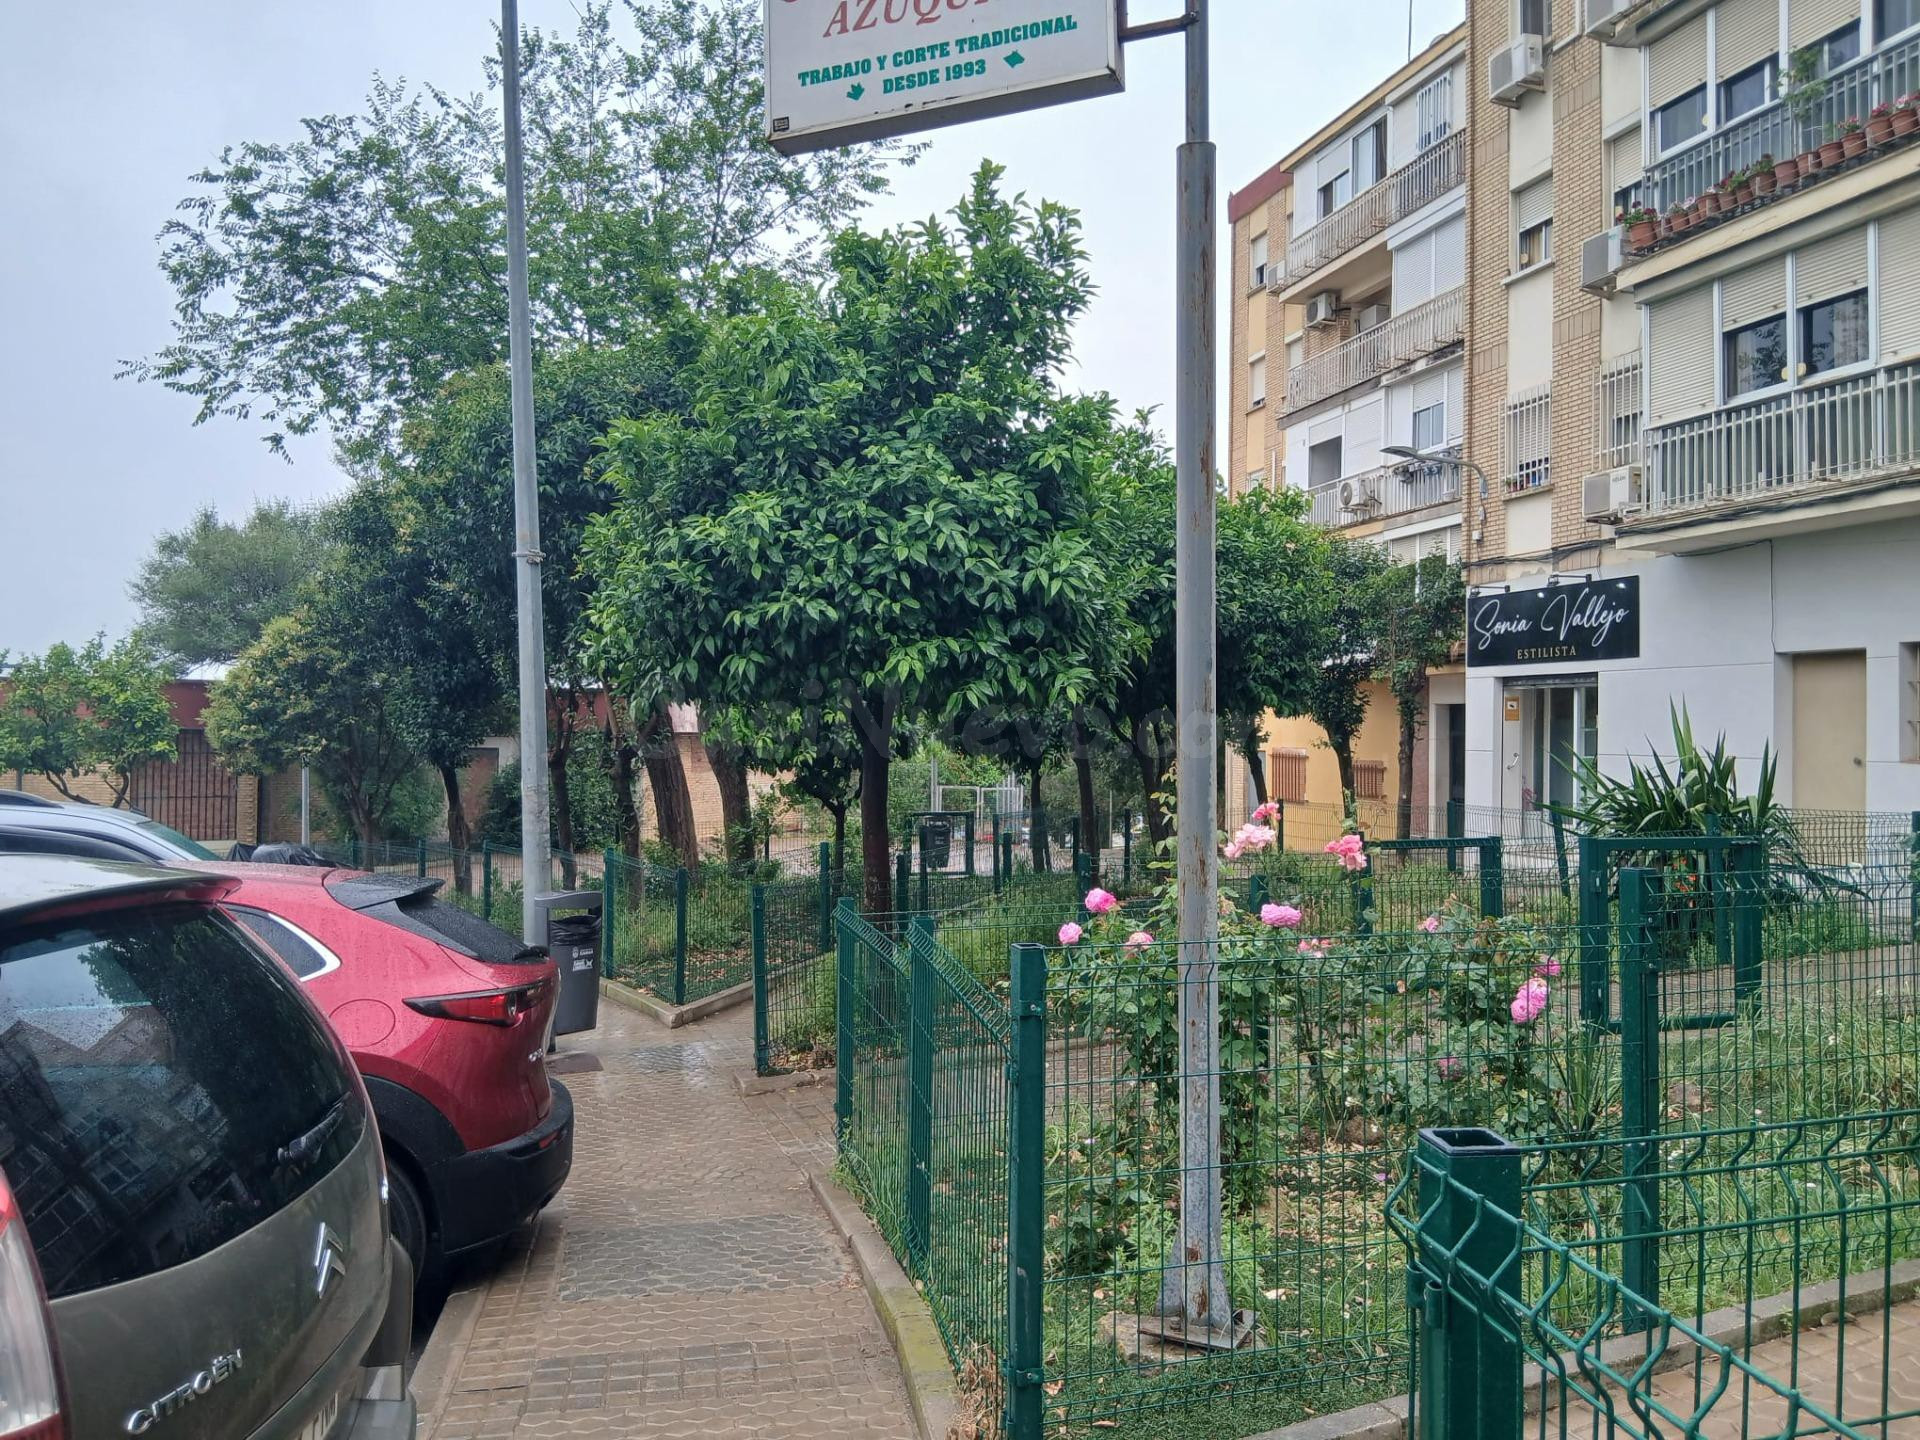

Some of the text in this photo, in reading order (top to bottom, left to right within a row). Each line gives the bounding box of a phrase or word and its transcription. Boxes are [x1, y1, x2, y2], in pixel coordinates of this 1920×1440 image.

[823, 0, 989, 37] AZUQ
[797, 14, 1078, 87] TRABAJO Y CORTE TRADICIONAL
[882, 59, 987, 95] DESDE 1993
[1474, 587, 1629, 650] Sonia Vallejo
[1517, 645, 1577, 660] ESTILISTA
[126, 1348, 244, 1435] CITROËN
